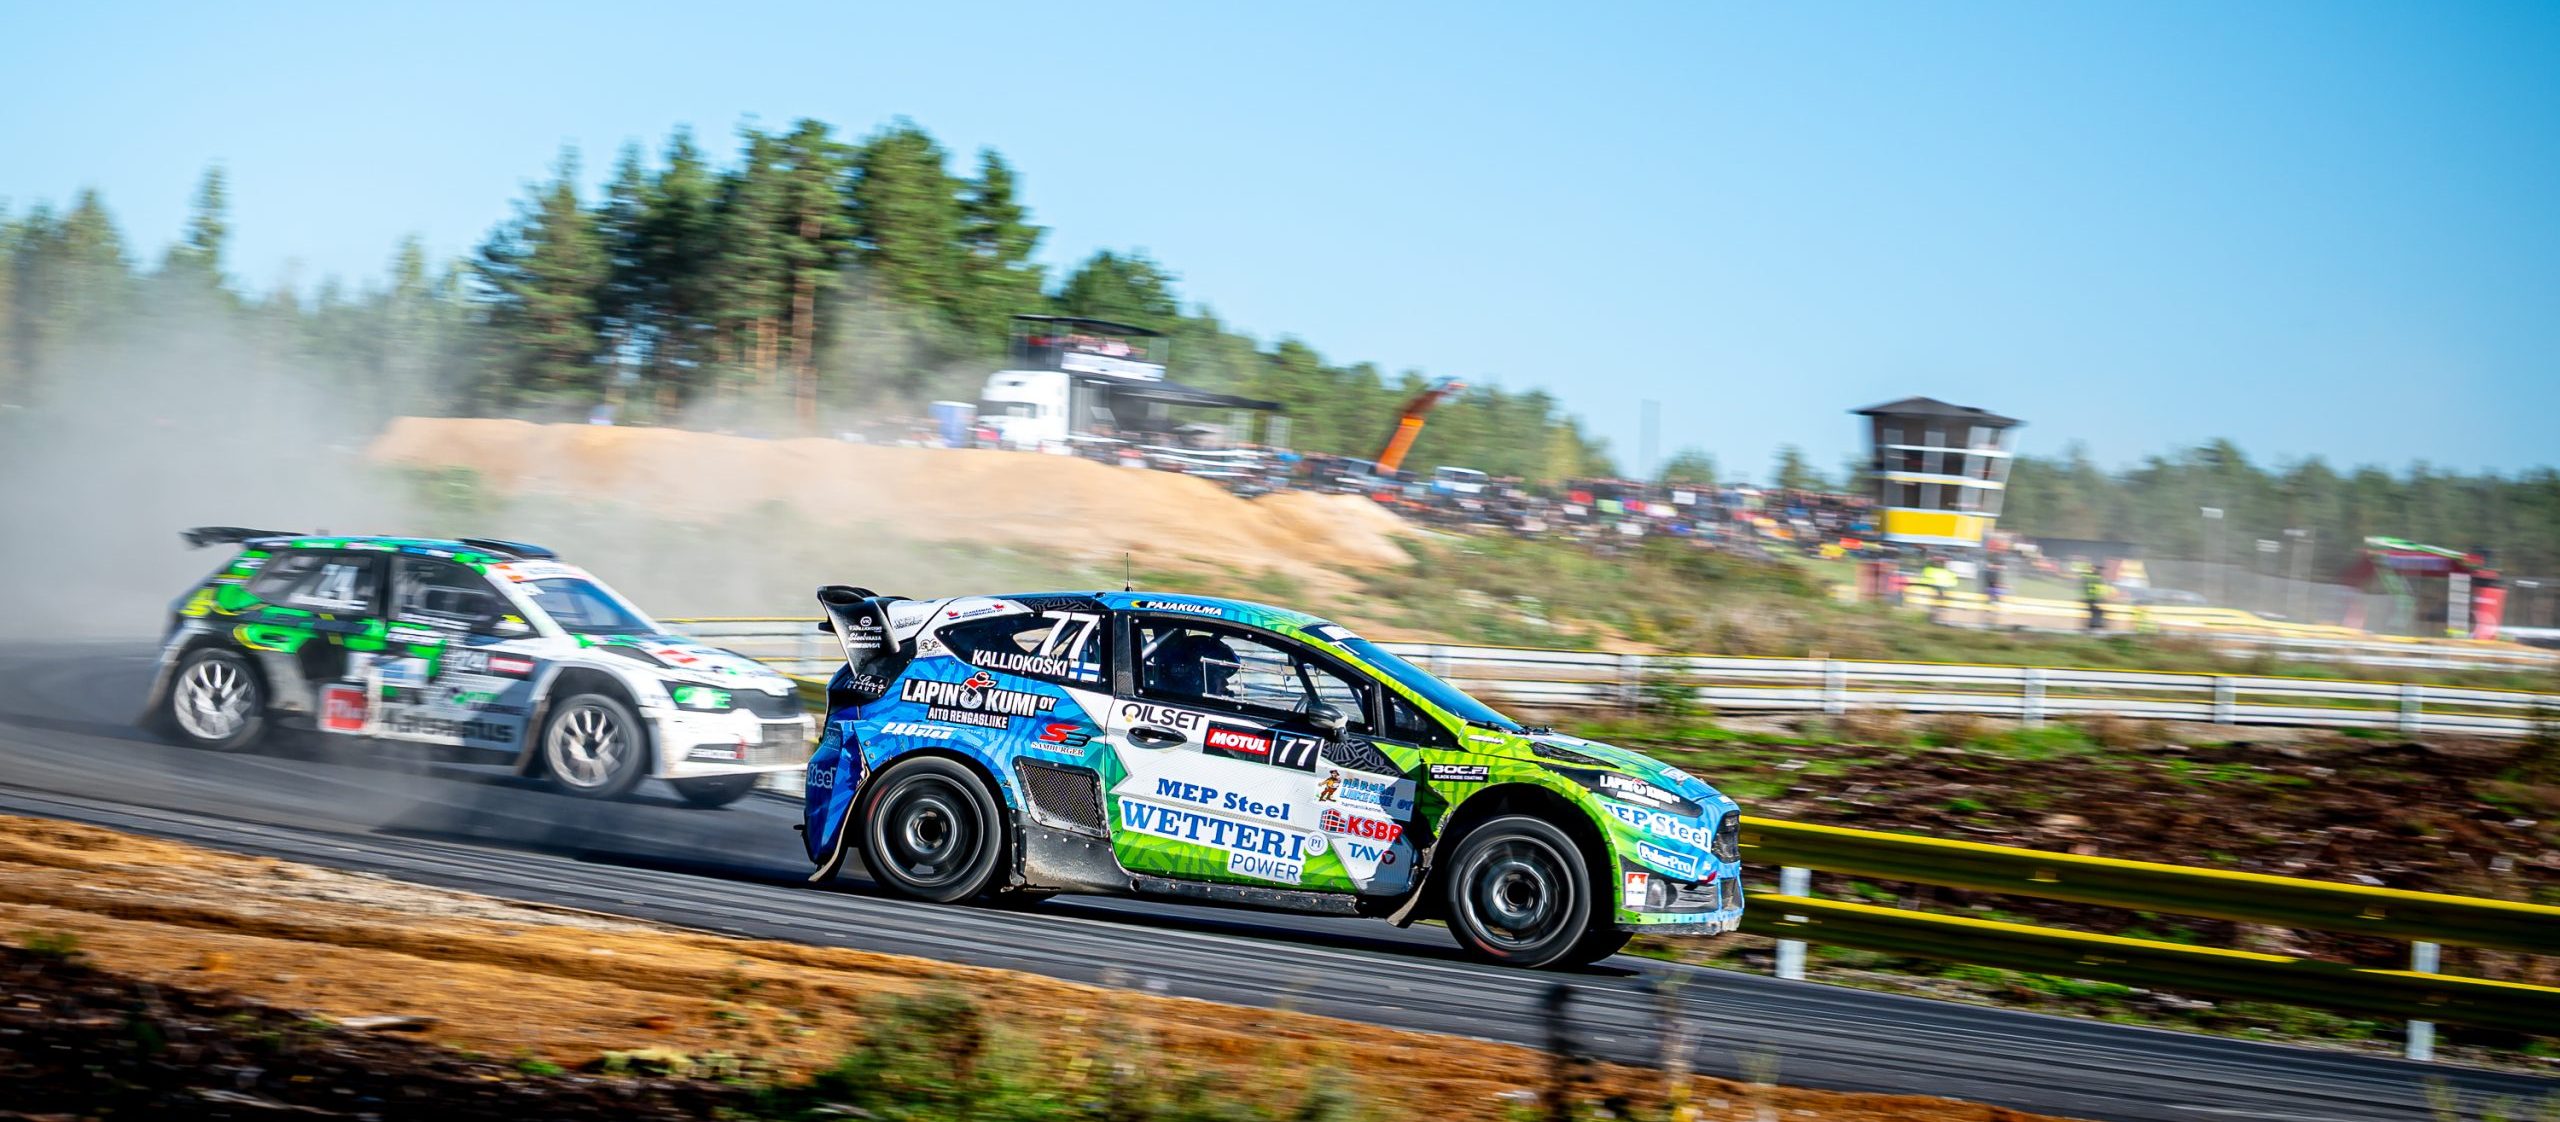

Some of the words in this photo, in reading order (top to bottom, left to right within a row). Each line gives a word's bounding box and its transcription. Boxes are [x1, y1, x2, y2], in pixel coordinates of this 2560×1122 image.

[1146, 601, 1223, 616] PAJAKULMA
[1039, 611, 1100, 660] 77
[972, 649, 1069, 677] KALLIOKOSKI
[901, 679, 961, 707] LAPIN
[985, 690, 1037, 717] KUMI
[1039, 697, 1057, 711] OY
[928, 709, 950, 721] AITO
[949, 710, 1009, 729] RENGASLIIKE
[1122, 703, 1205, 731] OILSET
[1032, 742, 1085, 757] SAMBURGER
[1209, 732, 1267, 752] MOTUL
[1278, 736, 1317, 767] 77
[1431, 765, 1489, 775] BOC.FI
[1156, 778, 1218, 804] MEP
[1223, 791, 1291, 821] Steel
[1122, 800, 1306, 862] WETTERI
[1347, 815, 1404, 845] KSBR
[1656, 815, 1711, 850] Steel
[1230, 853, 1299, 881] POWER
